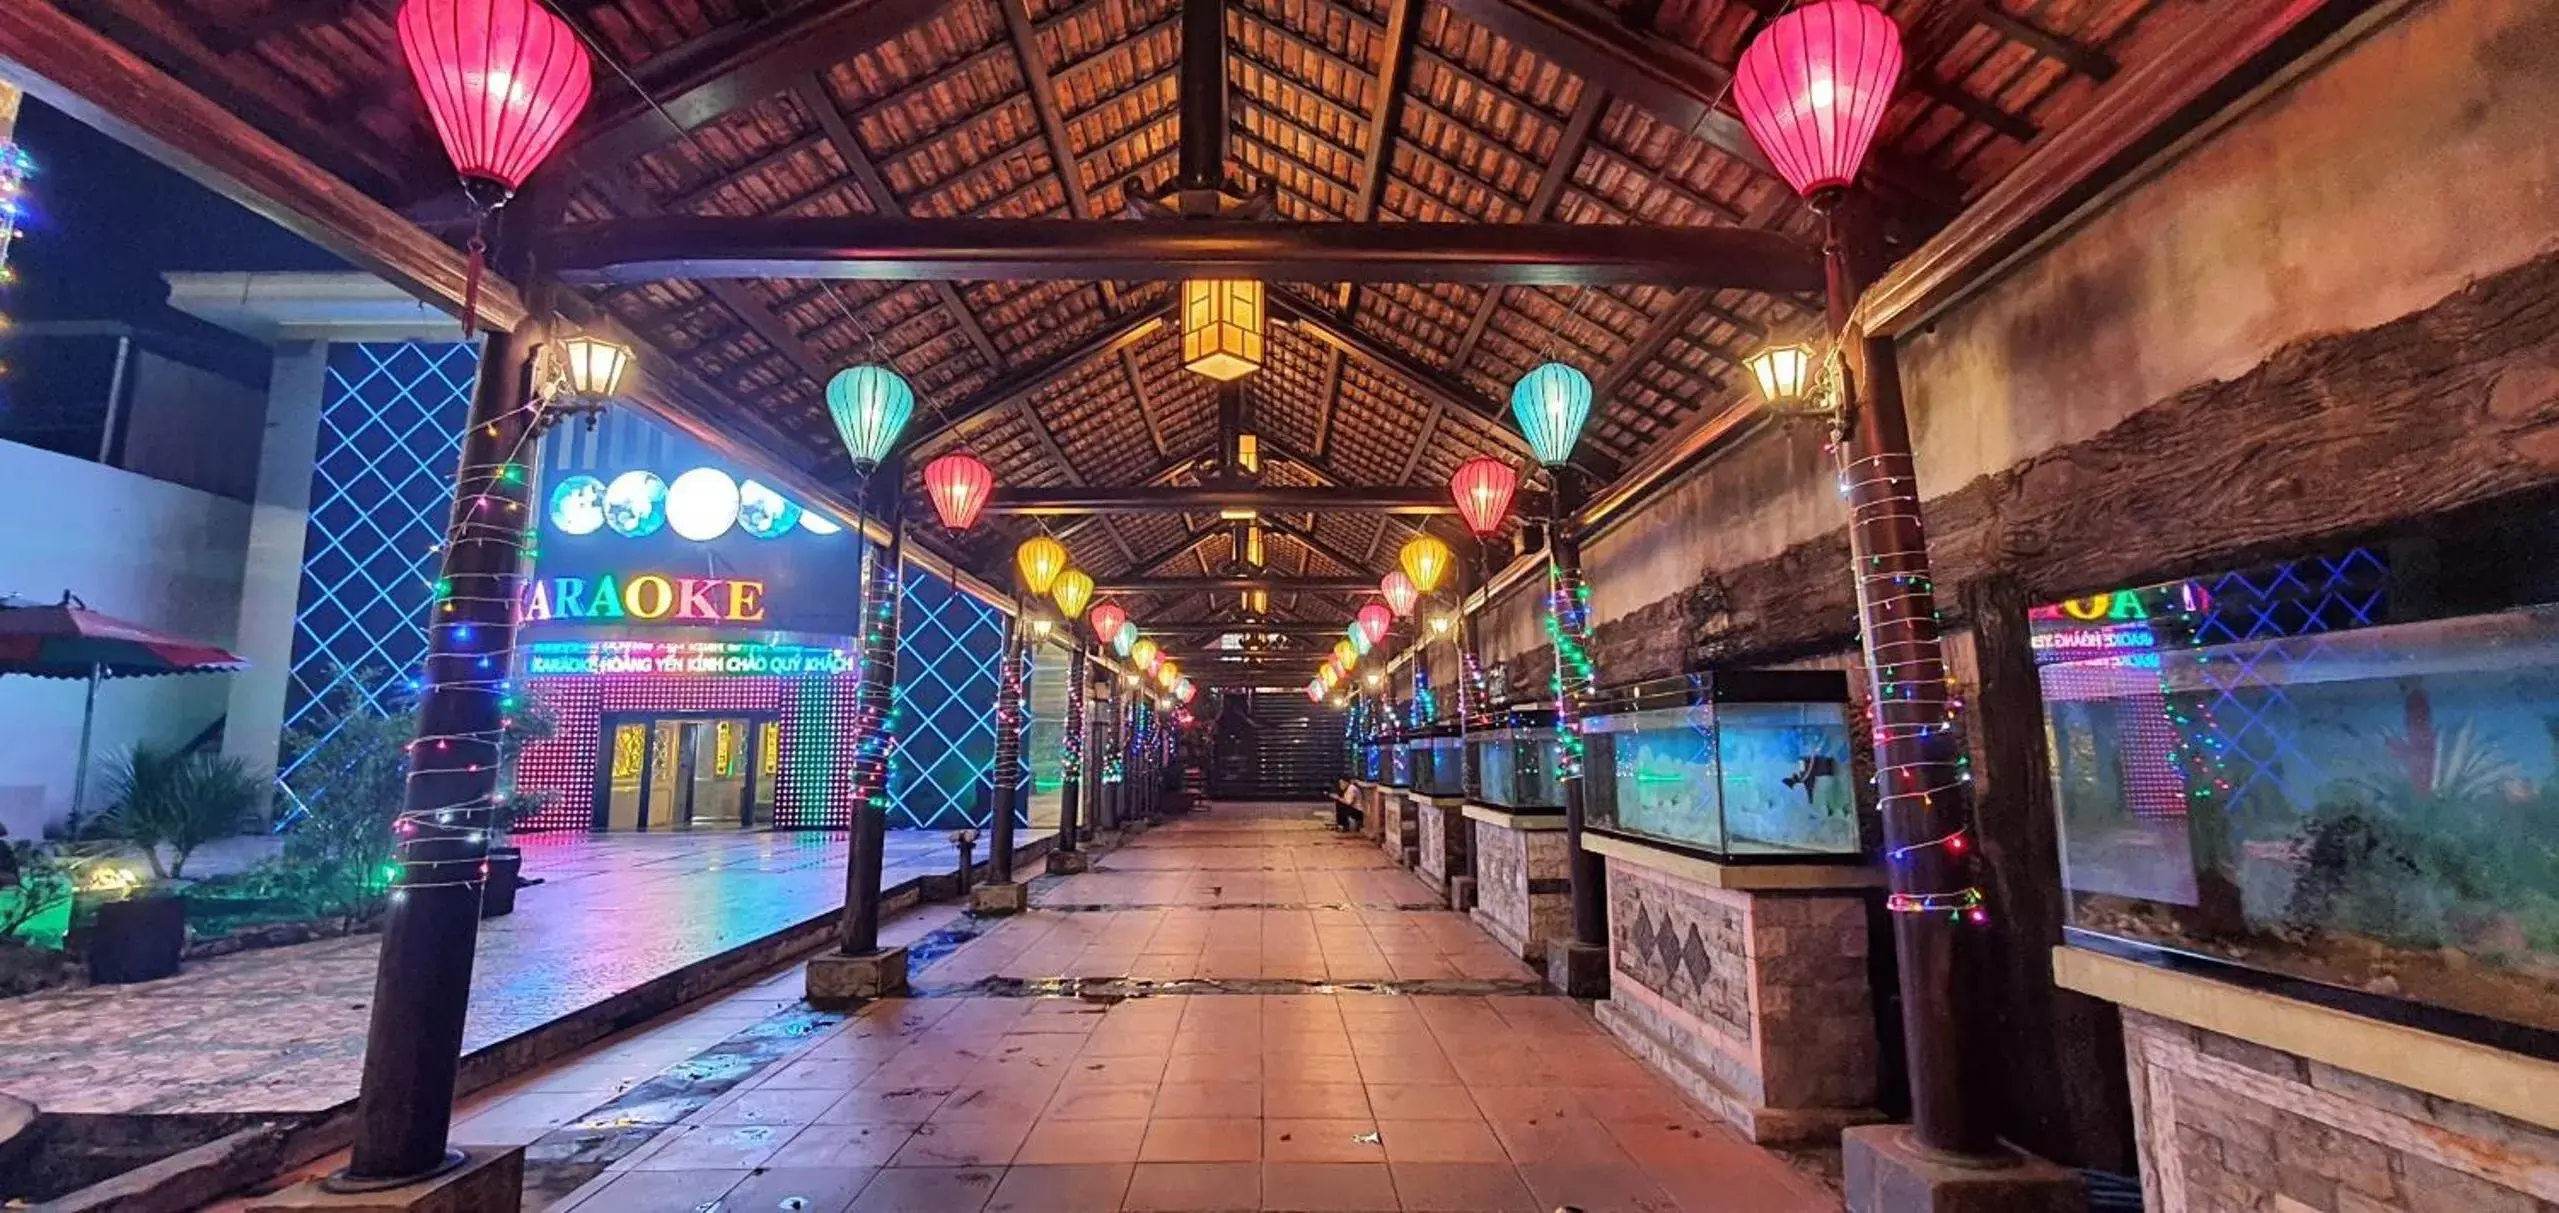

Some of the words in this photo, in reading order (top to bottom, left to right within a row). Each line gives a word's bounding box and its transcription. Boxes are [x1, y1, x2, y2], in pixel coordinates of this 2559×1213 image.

[600, 653, 653, 673] HOÀNG
[726, 652, 766, 673] CHÀO
[769, 654, 801, 674] QUÝ
